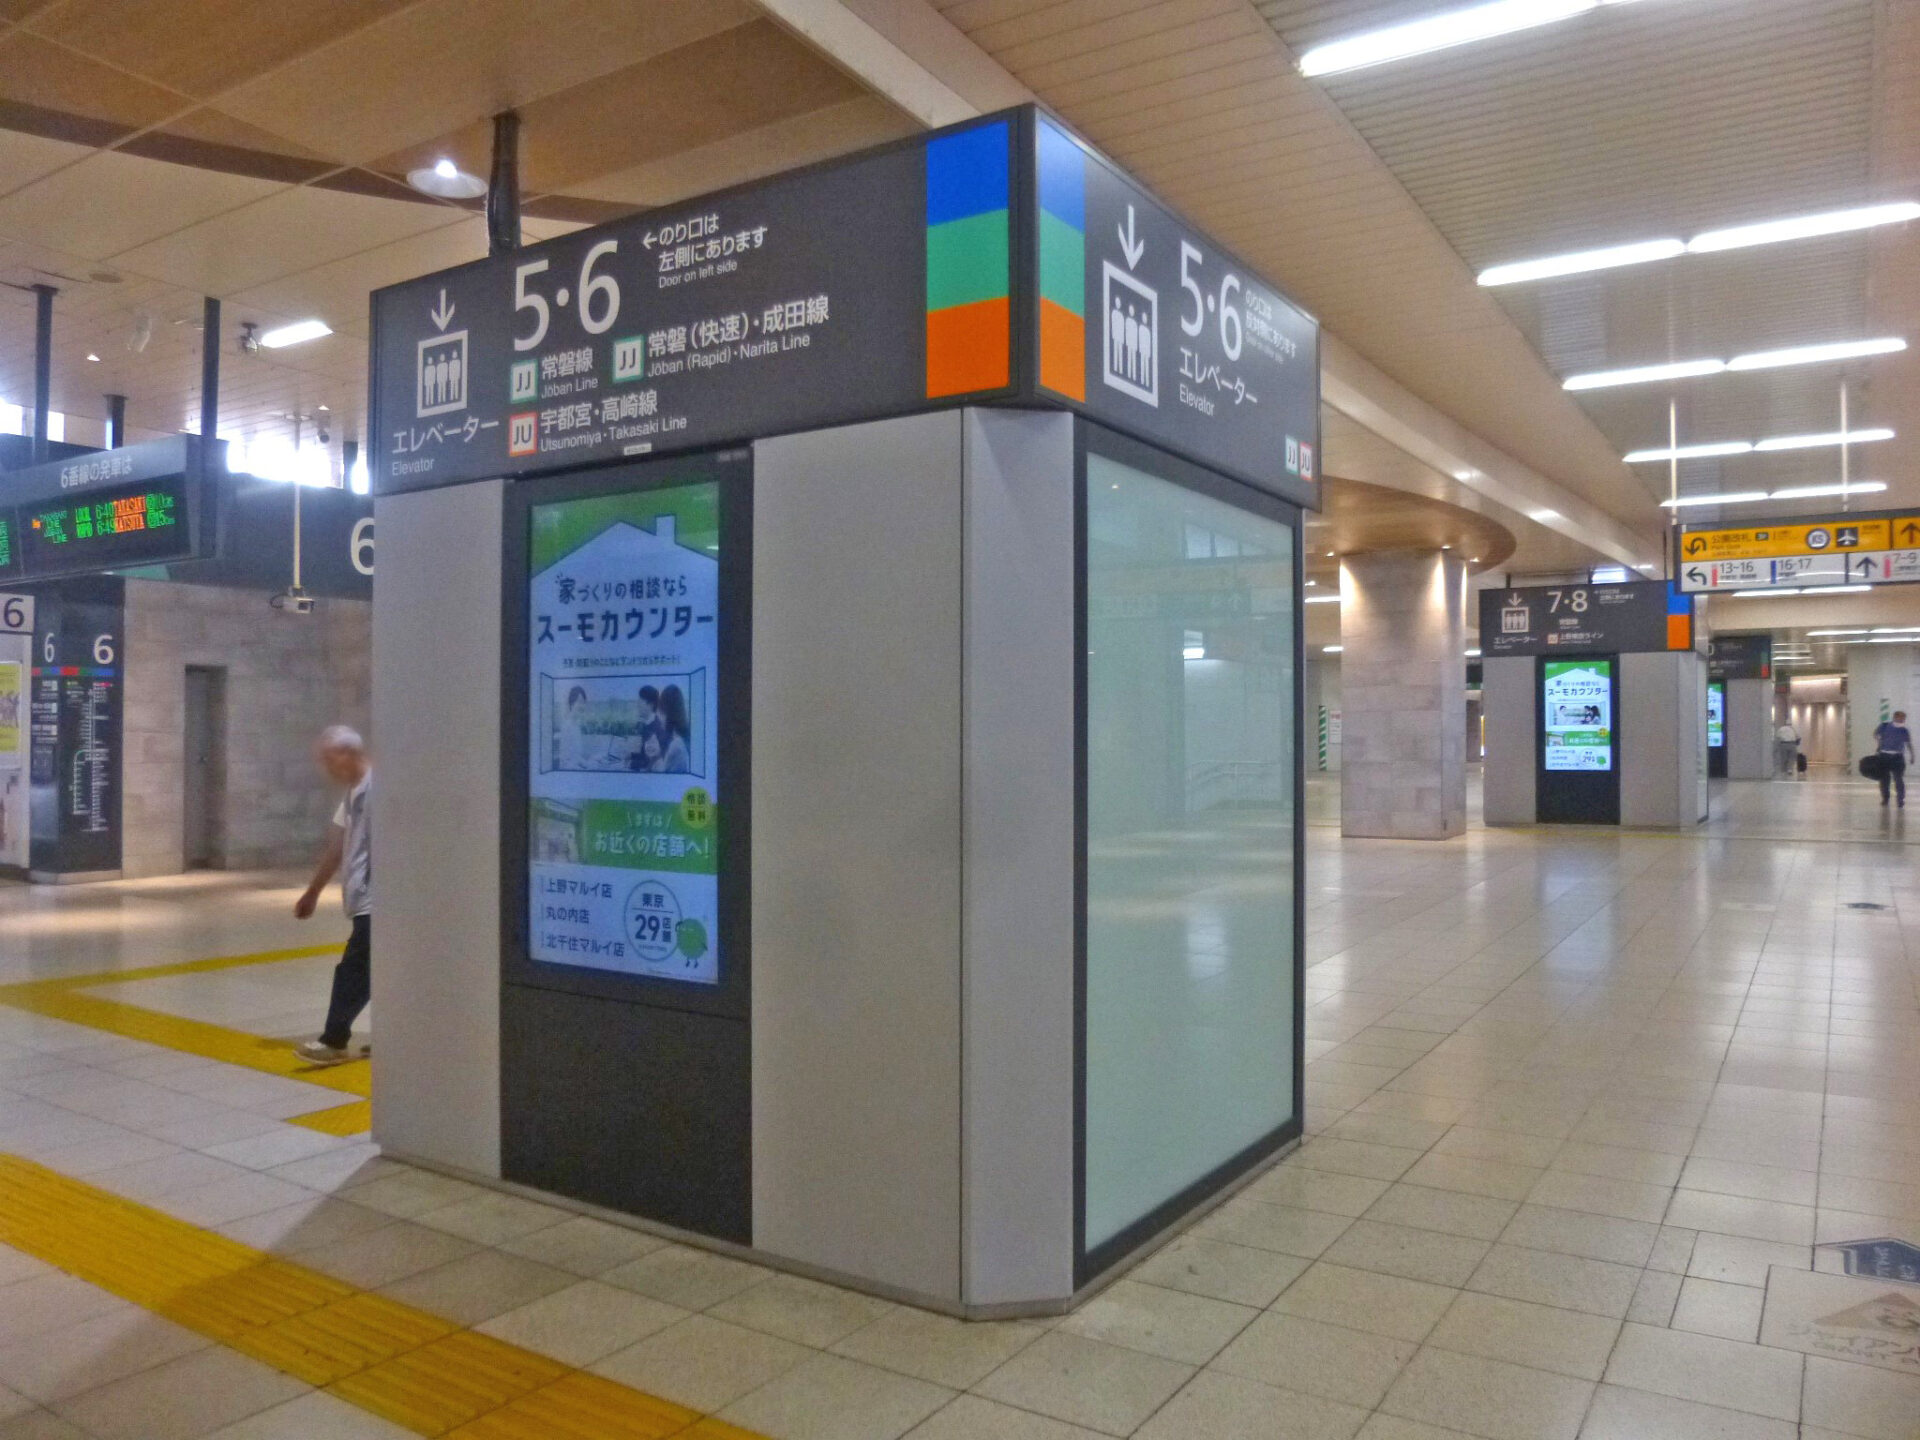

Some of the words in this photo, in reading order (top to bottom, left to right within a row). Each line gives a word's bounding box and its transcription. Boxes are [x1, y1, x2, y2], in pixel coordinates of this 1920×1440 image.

[659, 213, 719, 246] のり口は
[658, 226, 768, 273] 左側にあります
[659, 275, 681, 289] Door
[684, 270, 697, 283] on
[699, 265, 714, 279] left
[716, 259, 738, 275] side
[782, 333, 811, 350] Line
[541, 346, 594, 380] 常磐線
[620, 347, 636, 370] JJ
[516, 370, 531, 392] JJ
[575, 376, 599, 392] Line
[1179, 346, 1258, 406] エレベーター
[1179, 382, 1215, 417] Elevator
[391, 415, 500, 454] エレベーター
[514, 423, 532, 445] JU
[662, 416, 687, 432] Line
[392, 458, 435, 476] Elevator
[350, 517, 374, 576] 6
[559, 575, 687, 605] 家づくりの相談なら
[2, 597, 25, 629] 6
[538, 605, 714, 644] スーモカウンター
[43, 632, 56, 663] 6
[93, 634, 115, 665] 6
[1548, 687, 1608, 697] スーモカウンター
[546, 878, 615, 899] 上野マルイ店
[642, 893, 665, 908] 東京
[546, 906, 591, 925] 丸の内店
[546, 934, 626, 958] 北千住マルイ店
